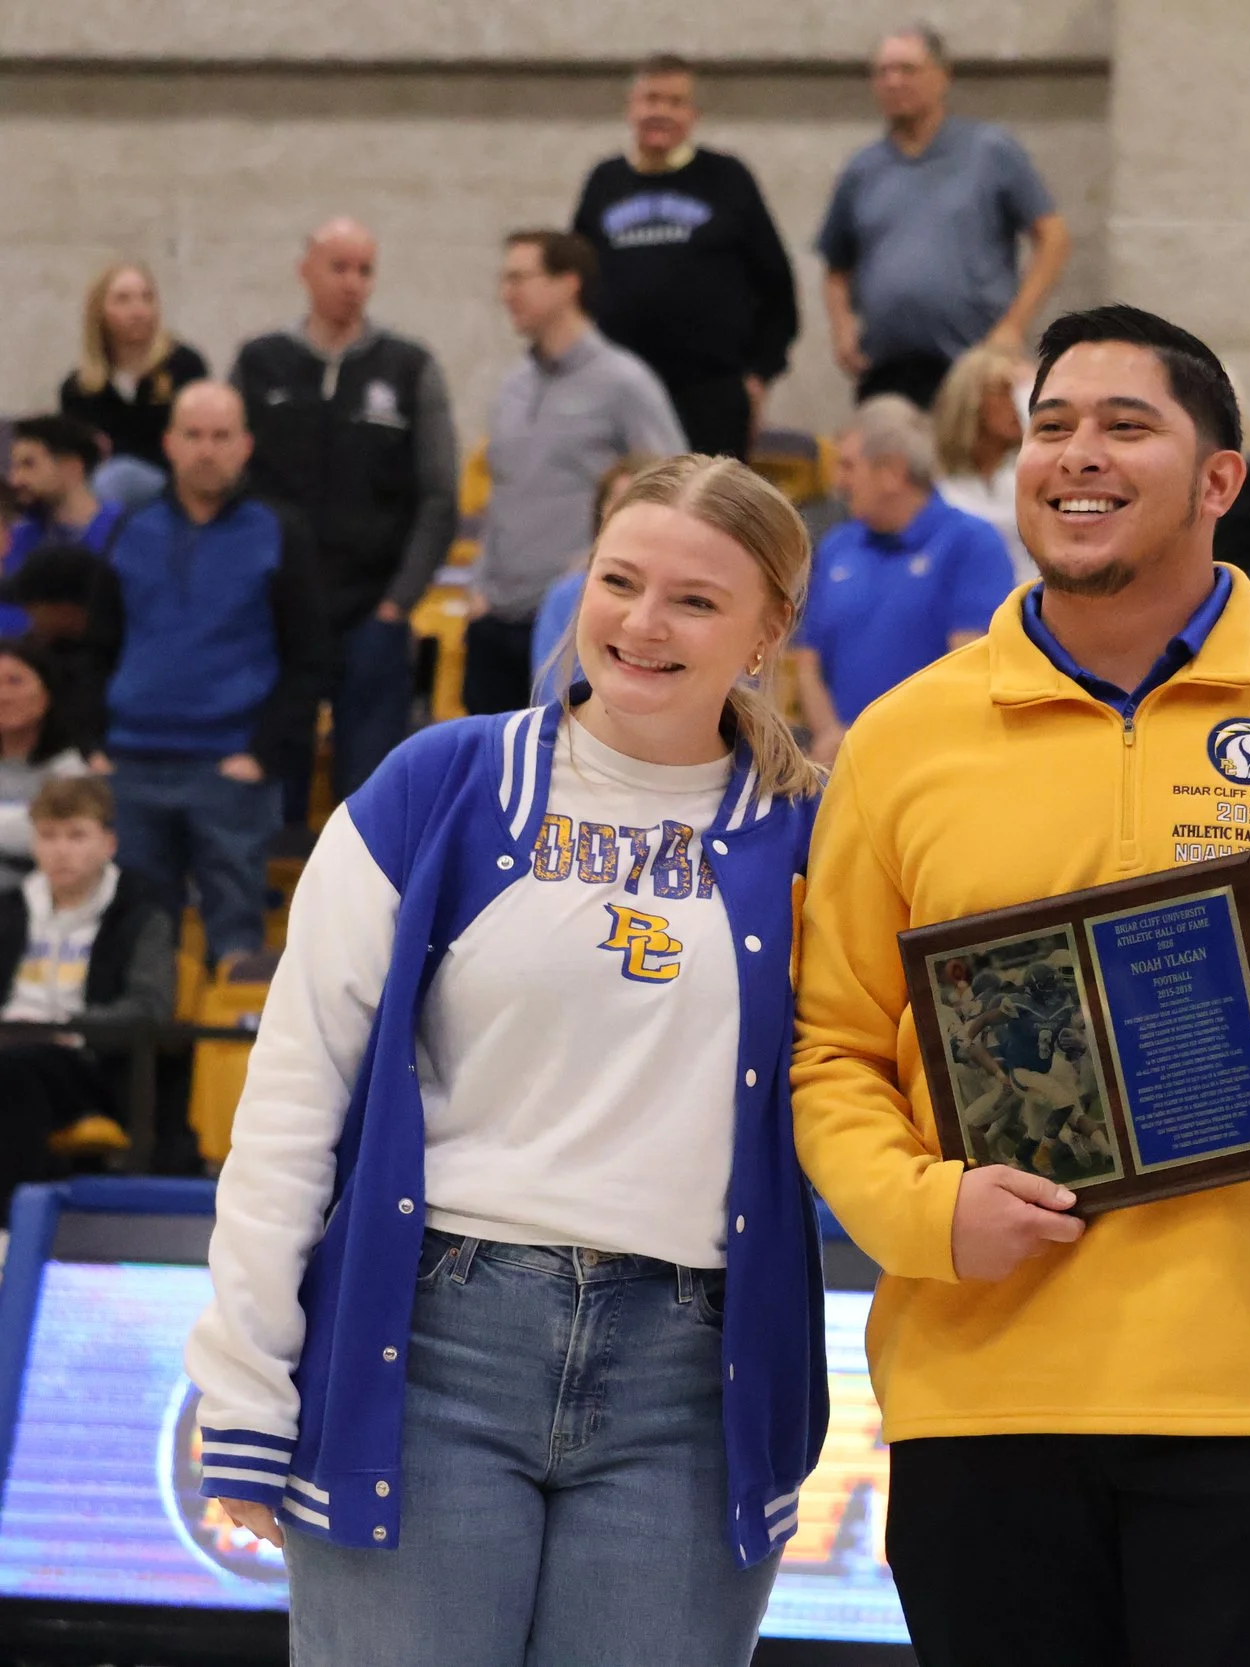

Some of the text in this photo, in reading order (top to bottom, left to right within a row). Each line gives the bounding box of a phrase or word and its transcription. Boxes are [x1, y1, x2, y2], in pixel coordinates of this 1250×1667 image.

[1173, 785, 1211, 796] BRIAR
[1214, 787, 1247, 798] CLIFF
[1172, 824, 1232, 840] ATHLETIC
[1175, 843, 1232, 862] NOAH
[1115, 905, 1206, 935] BRIAR CLIFF UNIVERSITY
[596, 902, 684, 984] BC
[1117, 918, 1209, 947] ATHLETIC HALL OF FAME
[1131, 946, 1207, 975] NOAH YLAGAN
[1153, 971, 1192, 987] FOOTBALL
